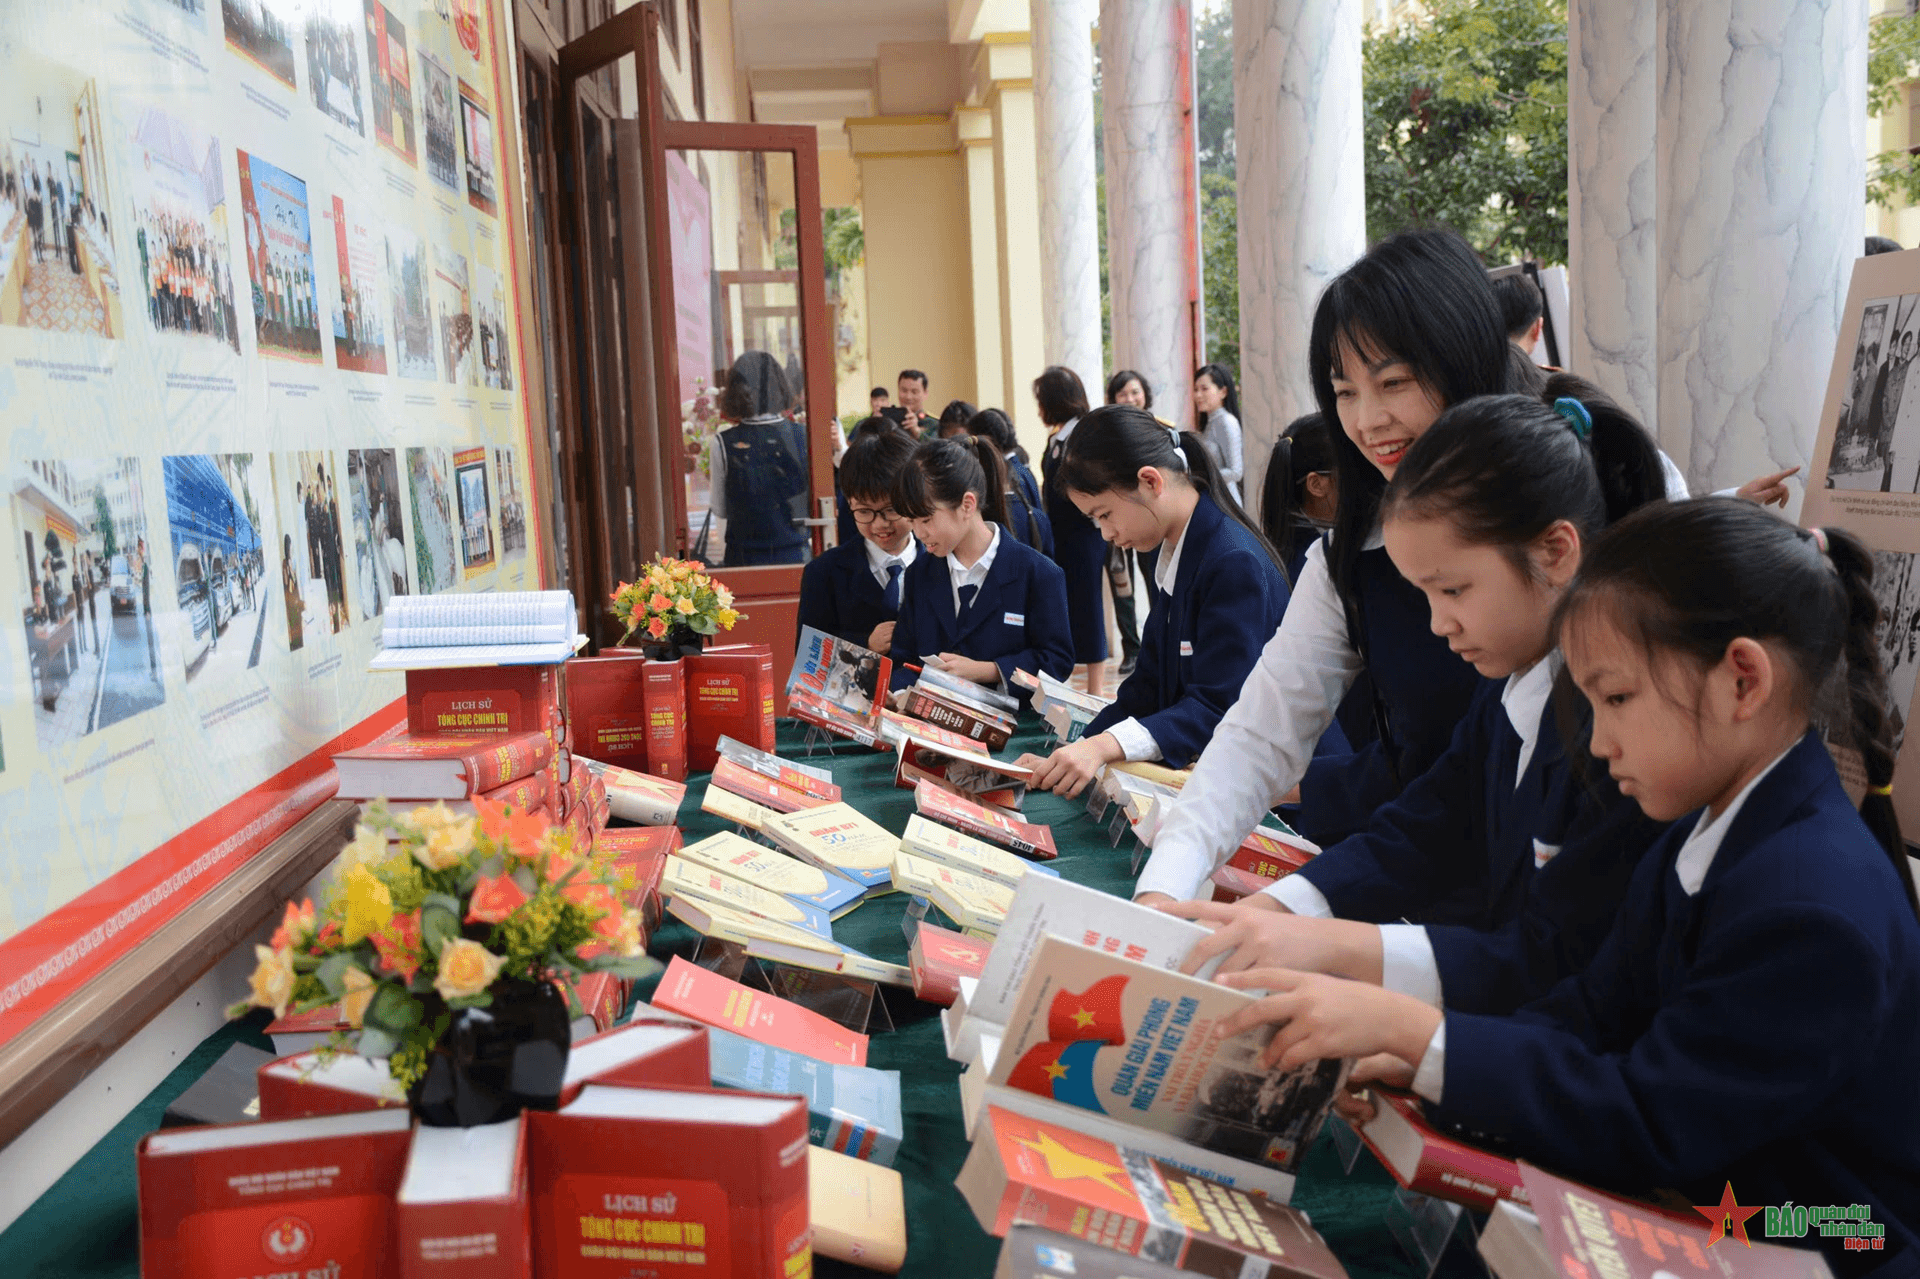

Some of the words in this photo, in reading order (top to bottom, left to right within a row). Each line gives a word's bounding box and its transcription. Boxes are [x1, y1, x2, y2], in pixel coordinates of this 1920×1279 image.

[452, 700, 476, 711] LỊCH
[478, 697, 492, 710] SỬ
[438, 711, 457, 727] TỔNG
[457, 713, 473, 728] CỤC
[473, 711, 495, 726] CHÍNH
[496, 712, 508, 726] TRỊ
[821, 833, 847, 844] 50
[1136, 998, 1171, 1040] PHÓNG
[1170, 996, 1199, 1027] NAM
[1126, 1038, 1151, 1064] GIẢI
[1158, 1025, 1185, 1051] VIỆT
[1144, 1051, 1173, 1080] NAM
[1111, 1063, 1139, 1096] QUÂN
[1130, 1080, 1160, 1111] MIỀN
[604, 1194, 648, 1214] LỊCH
[650, 1191, 677, 1215] SỬ
[580, 1215, 614, 1241] TỔNG
[614, 1217, 643, 1243] CỤC
[642, 1219, 682, 1245] CHÍNH
